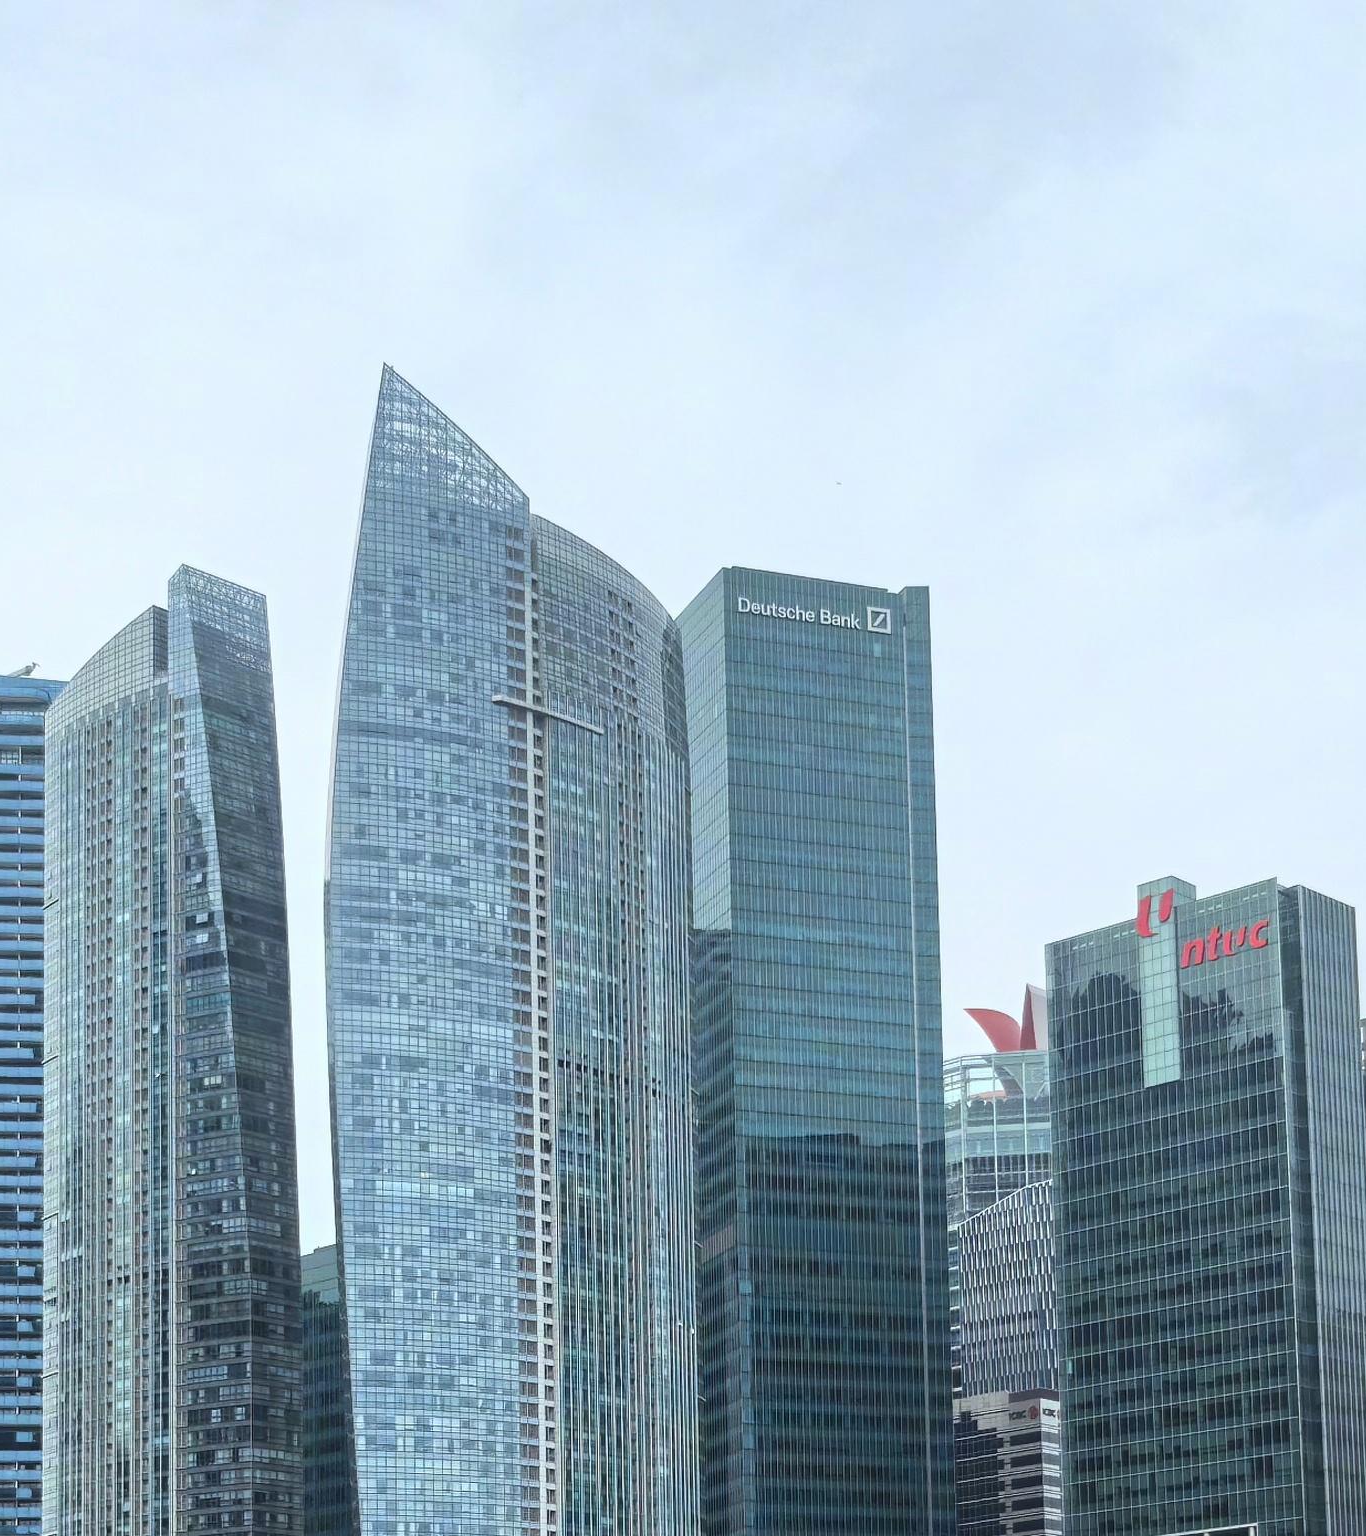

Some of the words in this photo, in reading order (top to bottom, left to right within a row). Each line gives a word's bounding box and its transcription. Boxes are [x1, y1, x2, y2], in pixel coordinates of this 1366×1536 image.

[738, 597, 815, 623] Deutsche
[820, 608, 861, 630] Bank
[1180, 919, 1269, 969] ntuc
